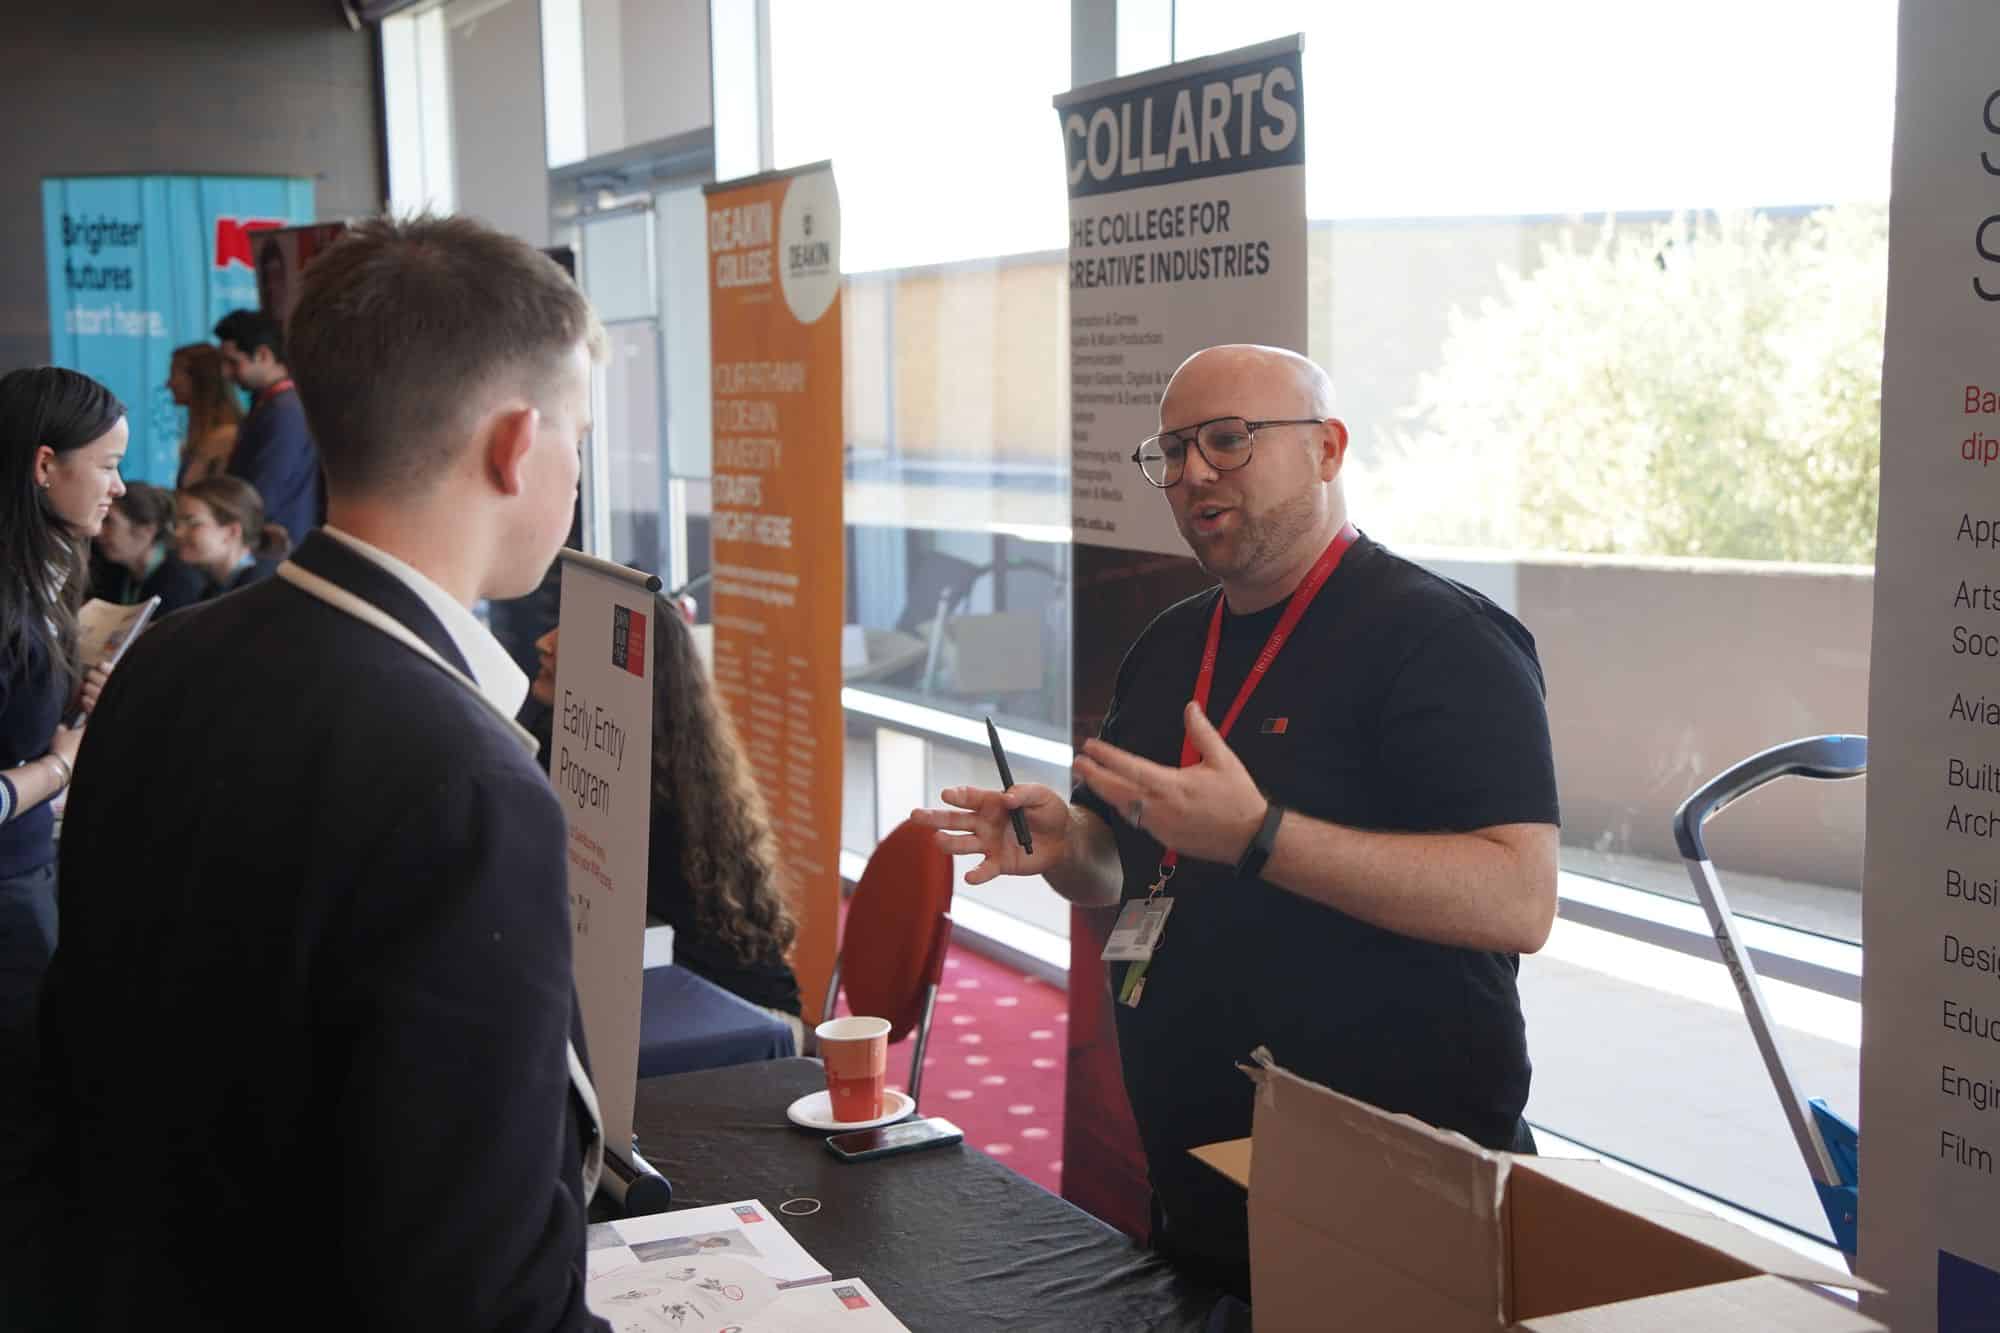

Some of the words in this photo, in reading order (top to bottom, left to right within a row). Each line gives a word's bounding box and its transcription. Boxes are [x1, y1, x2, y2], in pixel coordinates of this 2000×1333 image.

[1065, 66, 1297, 185] COLLARTS
[62, 212, 143, 255] Brighter
[710, 202, 772, 251] DEAKIN
[1071, 217, 1094, 248] HE
[1099, 205, 1185, 246] COLLEGE
[1189, 200, 1230, 238] FOR
[64, 255, 134, 291] futures
[716, 249, 772, 288] COLLEGE
[788, 242, 830, 269] DEAKIN
[1150, 241, 1270, 283] INDUSTRIES
[64, 304, 112, 337] start
[1954, 580, 2000, 612] Arts
[563, 690, 593, 751] Early
[595, 706, 626, 773] Entry
[560, 746, 610, 817] Program
[1944, 935, 2000, 981] Desi
[1941, 1130, 1992, 1175] Film
